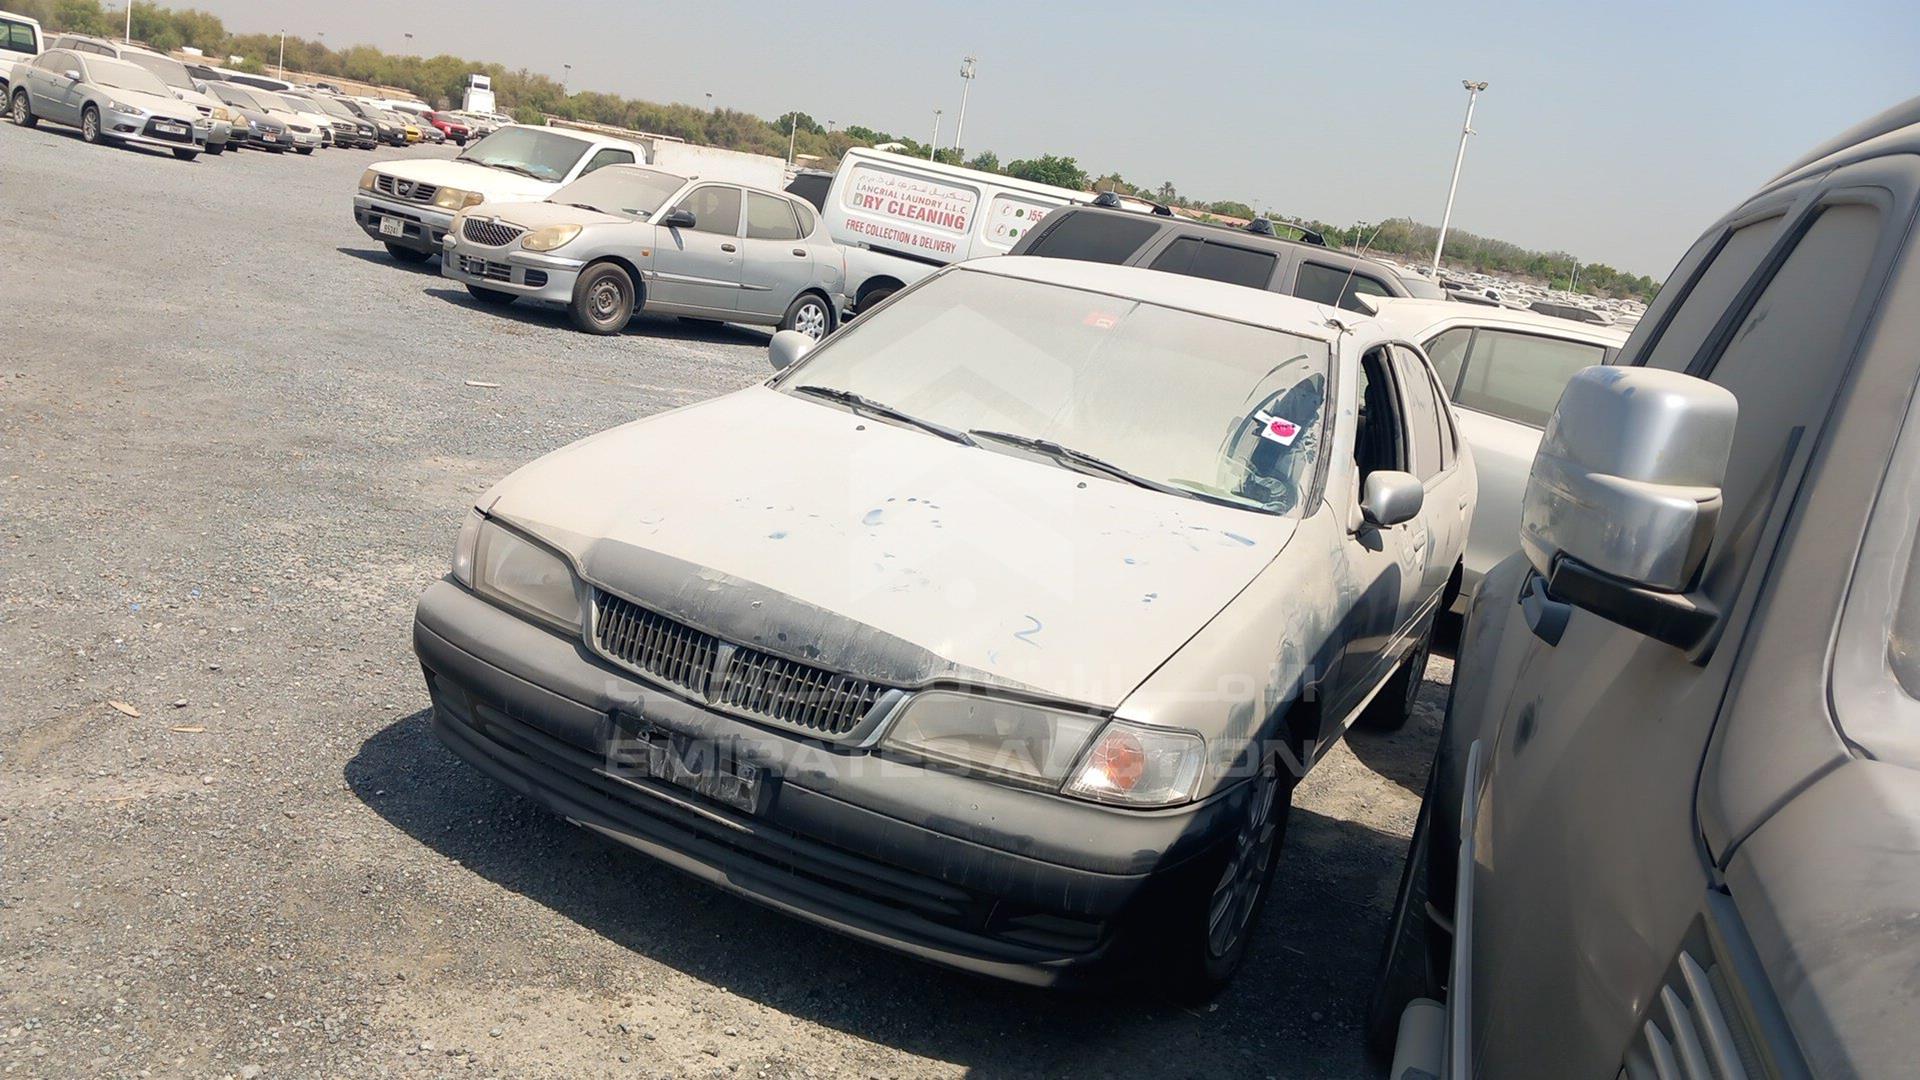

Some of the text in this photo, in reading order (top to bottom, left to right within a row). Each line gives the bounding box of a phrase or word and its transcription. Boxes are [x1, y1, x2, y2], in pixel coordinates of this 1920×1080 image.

[853, 192, 966, 230] DRY CLEANING
[856, 183, 898, 199] LANCRIAL
[901, 192, 942, 208] LAUNDRY
[845, 219, 957, 254] FREE COLLECTION & DELIVERY
